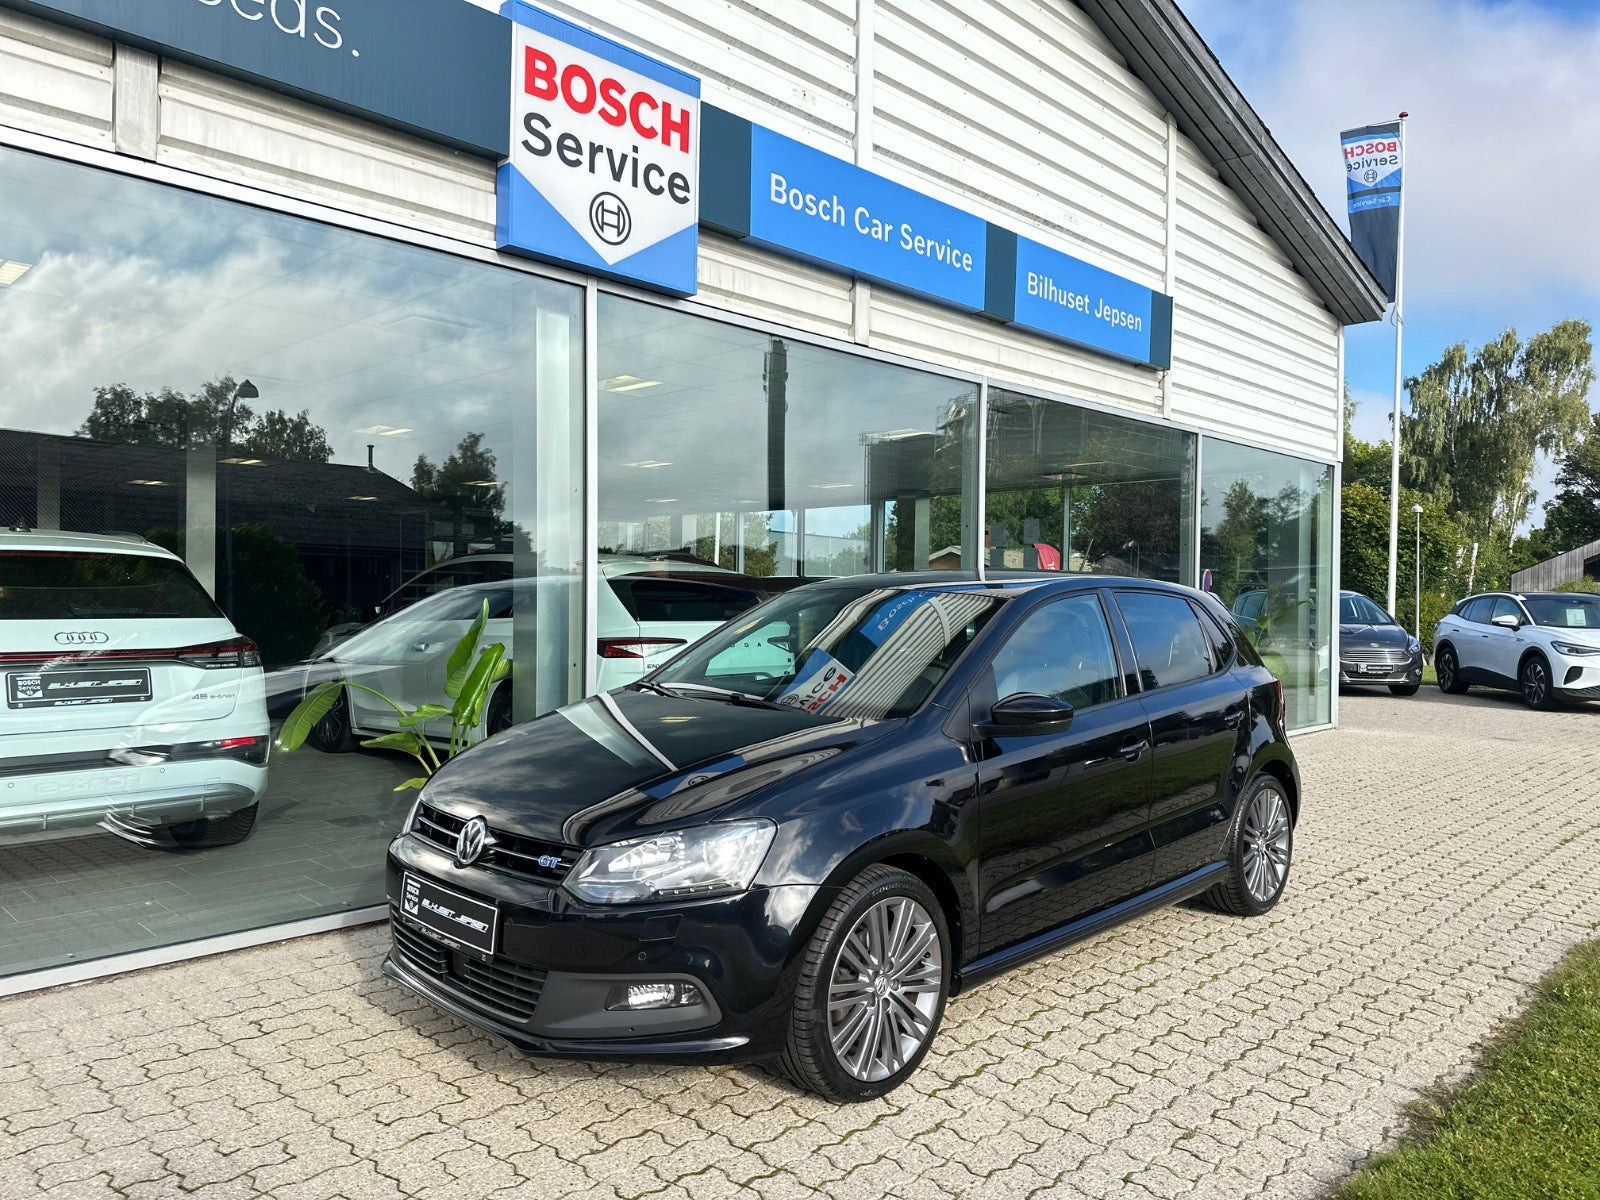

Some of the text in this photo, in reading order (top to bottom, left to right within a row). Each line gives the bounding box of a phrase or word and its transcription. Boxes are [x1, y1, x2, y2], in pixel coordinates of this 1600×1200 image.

[525, 45, 690, 154] BOSCH
[521, 112, 691, 205] Service
[770, 172, 973, 273] Bosch Car Service
[1027, 271, 1142, 332] Bilhuset Jepsen
[539, 855, 562, 868] GT
